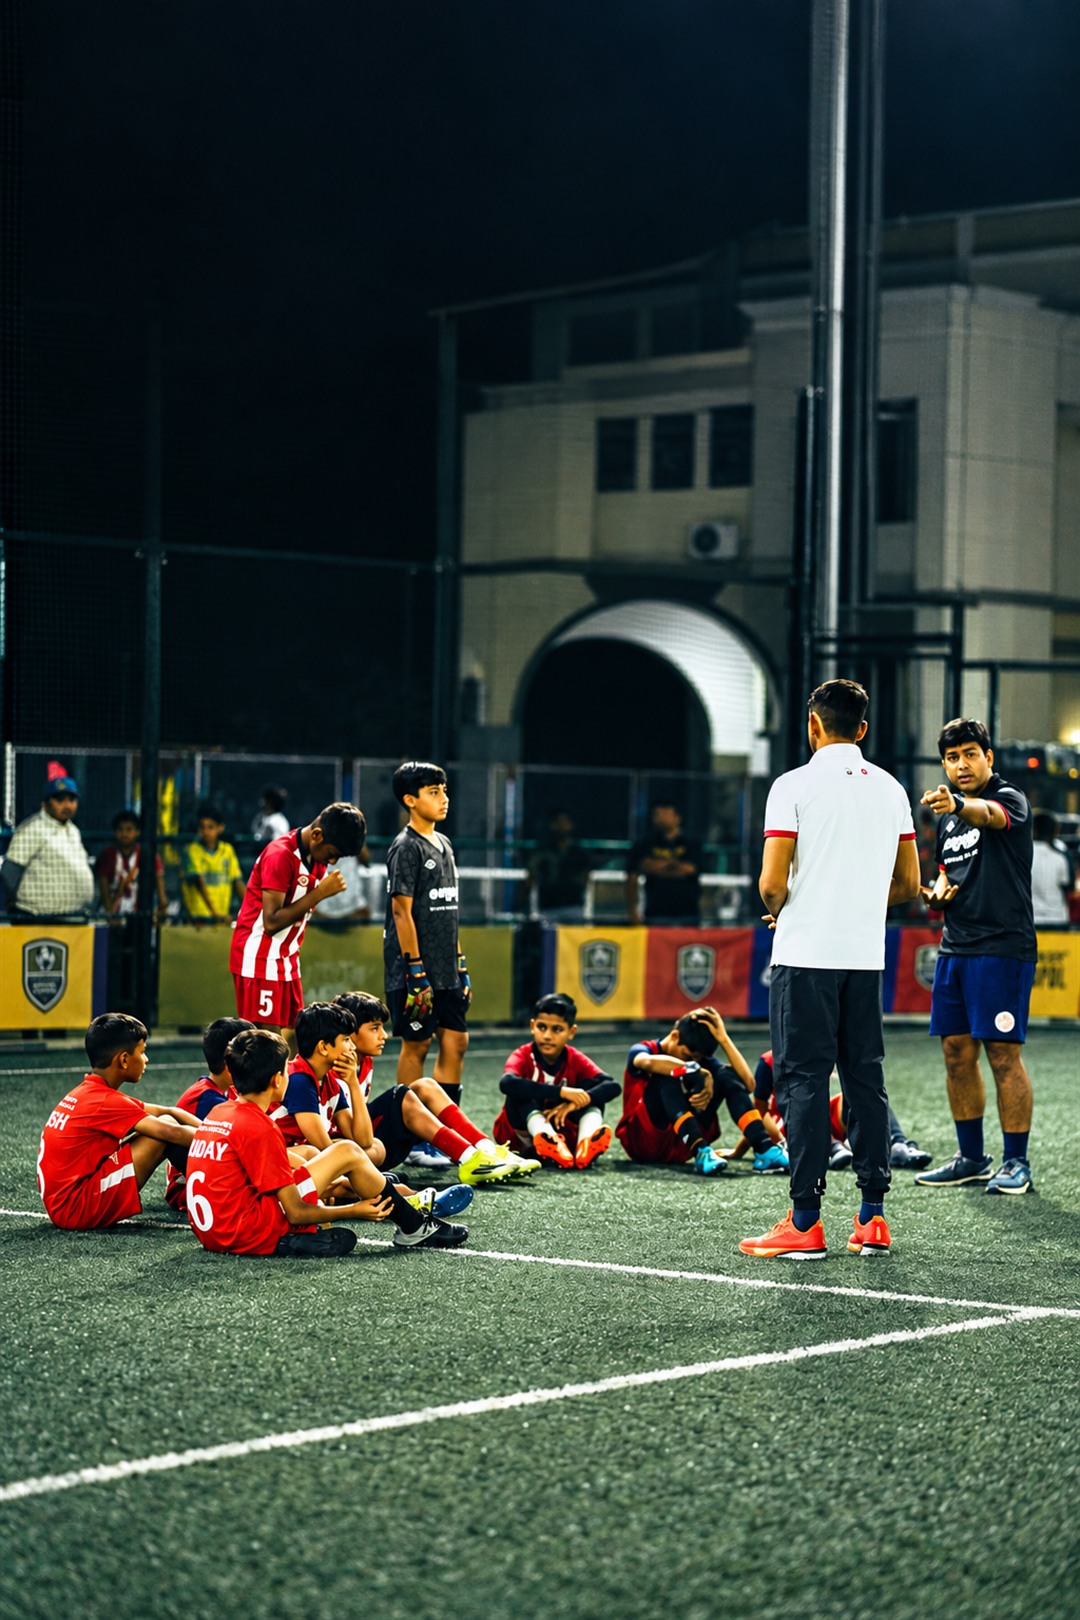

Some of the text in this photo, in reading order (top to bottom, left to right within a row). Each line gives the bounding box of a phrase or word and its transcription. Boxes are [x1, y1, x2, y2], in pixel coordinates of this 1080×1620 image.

[258, 989, 273, 1017] 5
[188, 1138, 229, 1161] UDAY
[186, 1170, 214, 1232] 6
